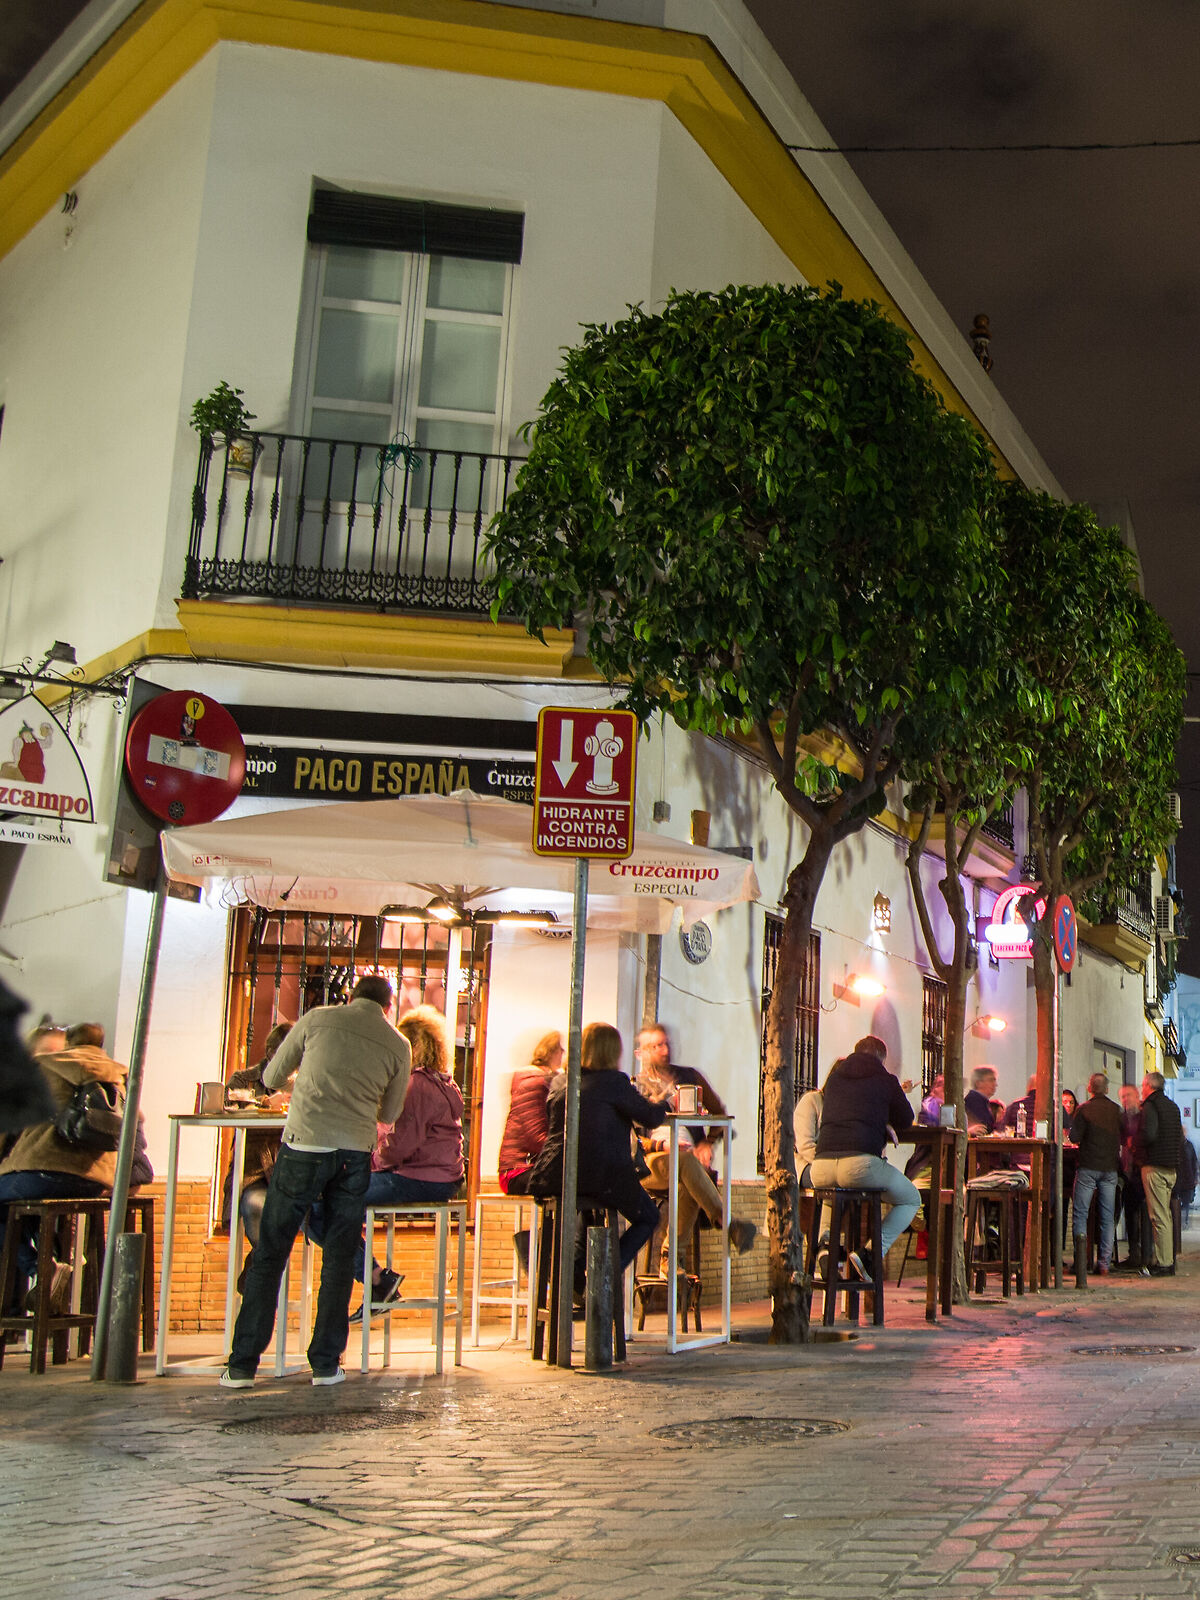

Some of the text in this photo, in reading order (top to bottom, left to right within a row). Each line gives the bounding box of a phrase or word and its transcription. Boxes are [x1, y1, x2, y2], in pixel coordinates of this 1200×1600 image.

[294, 756, 471, 797] PACO ESPAÑA
[543, 806, 625, 821] HIDRANTE
[11, 830, 35, 839] PACO
[548, 821, 618, 835] CONTRA
[538, 834, 627, 850] INCENDIOS
[609, 861, 719, 882] Cruzcampo
[634, 883, 698, 896] ESPECIAL
